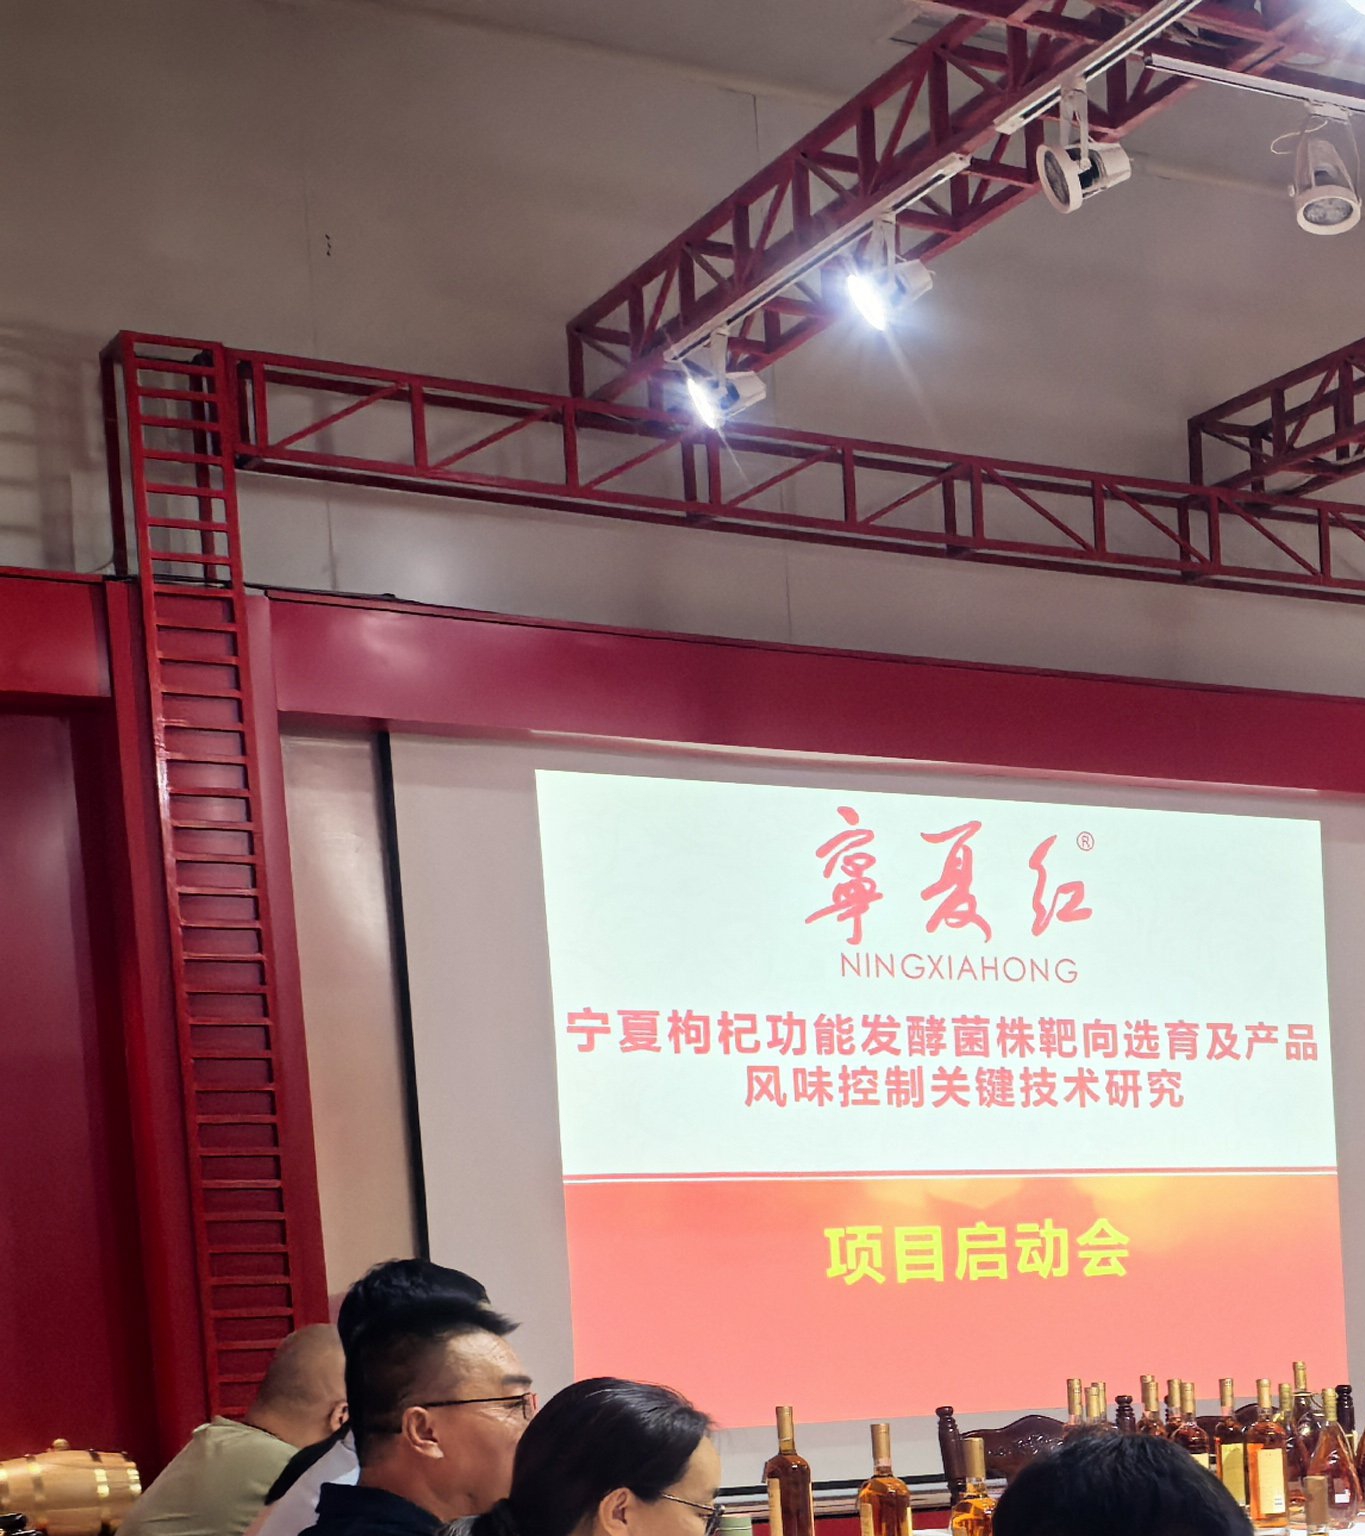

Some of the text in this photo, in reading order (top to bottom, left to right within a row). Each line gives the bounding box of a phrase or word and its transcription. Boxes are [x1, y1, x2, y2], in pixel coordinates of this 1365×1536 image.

[841, 952, 1078, 984] NINGXIAHONG
[565, 1007, 1320, 1064] 宁夏枸杞功能发酵菌株靶向选育及产品
[744, 1065, 1185, 1110] 风味控制关键技术研究
[825, 1218, 1130, 1285] 项目启动会
